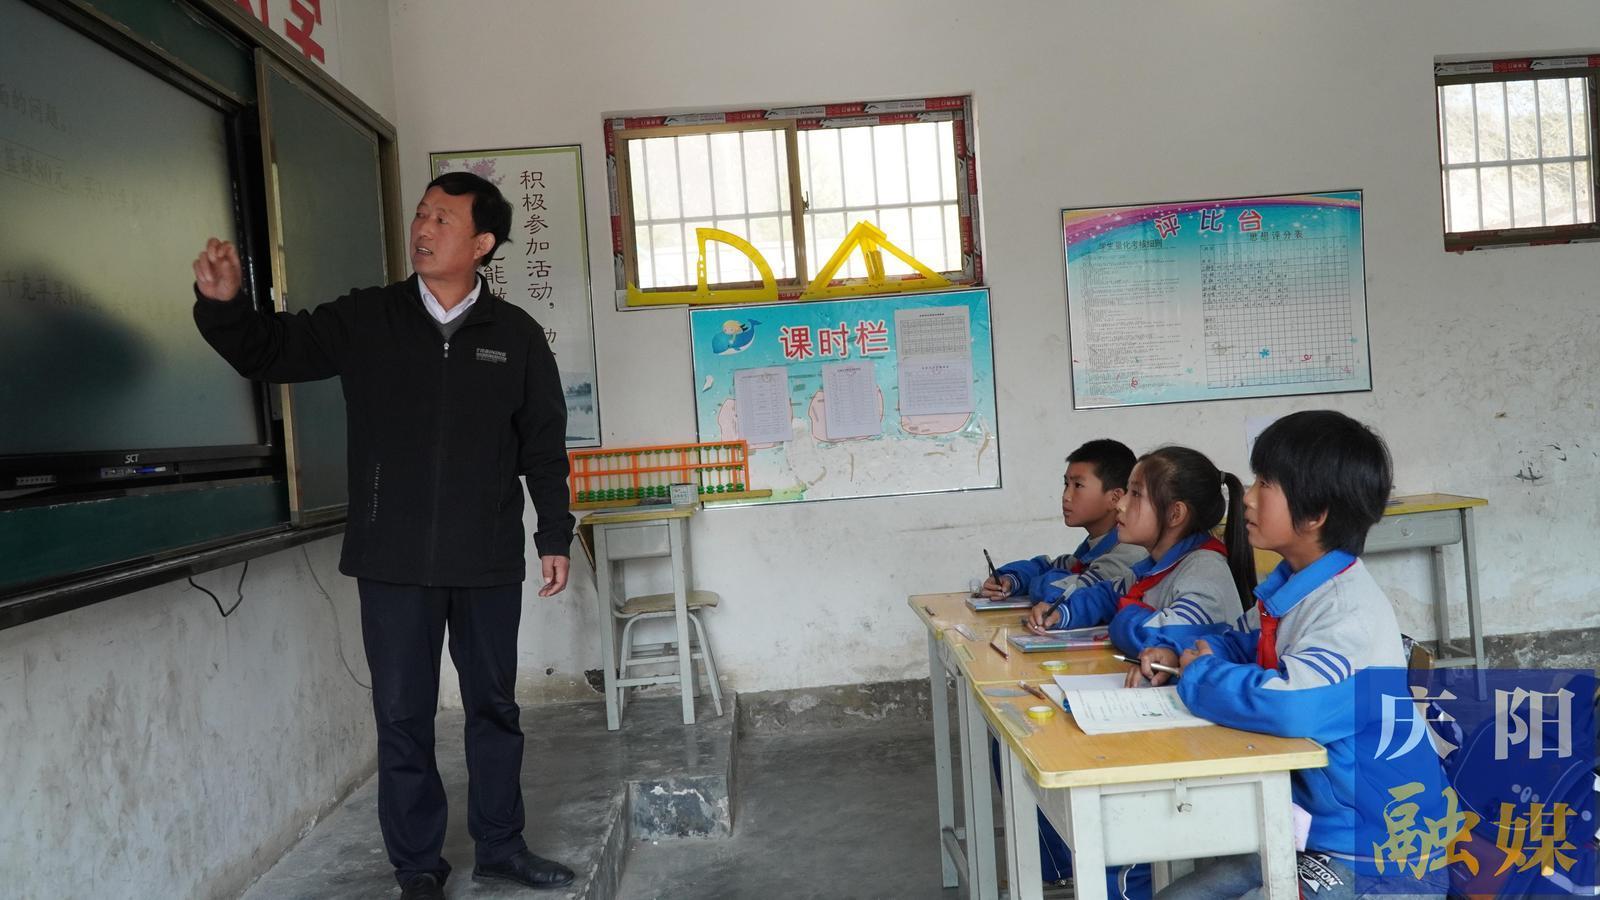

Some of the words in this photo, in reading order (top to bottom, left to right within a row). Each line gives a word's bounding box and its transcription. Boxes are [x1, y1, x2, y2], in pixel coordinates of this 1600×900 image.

[1154, 208, 1264, 239] 评比台
[779, 318, 890, 361] 课时栏
